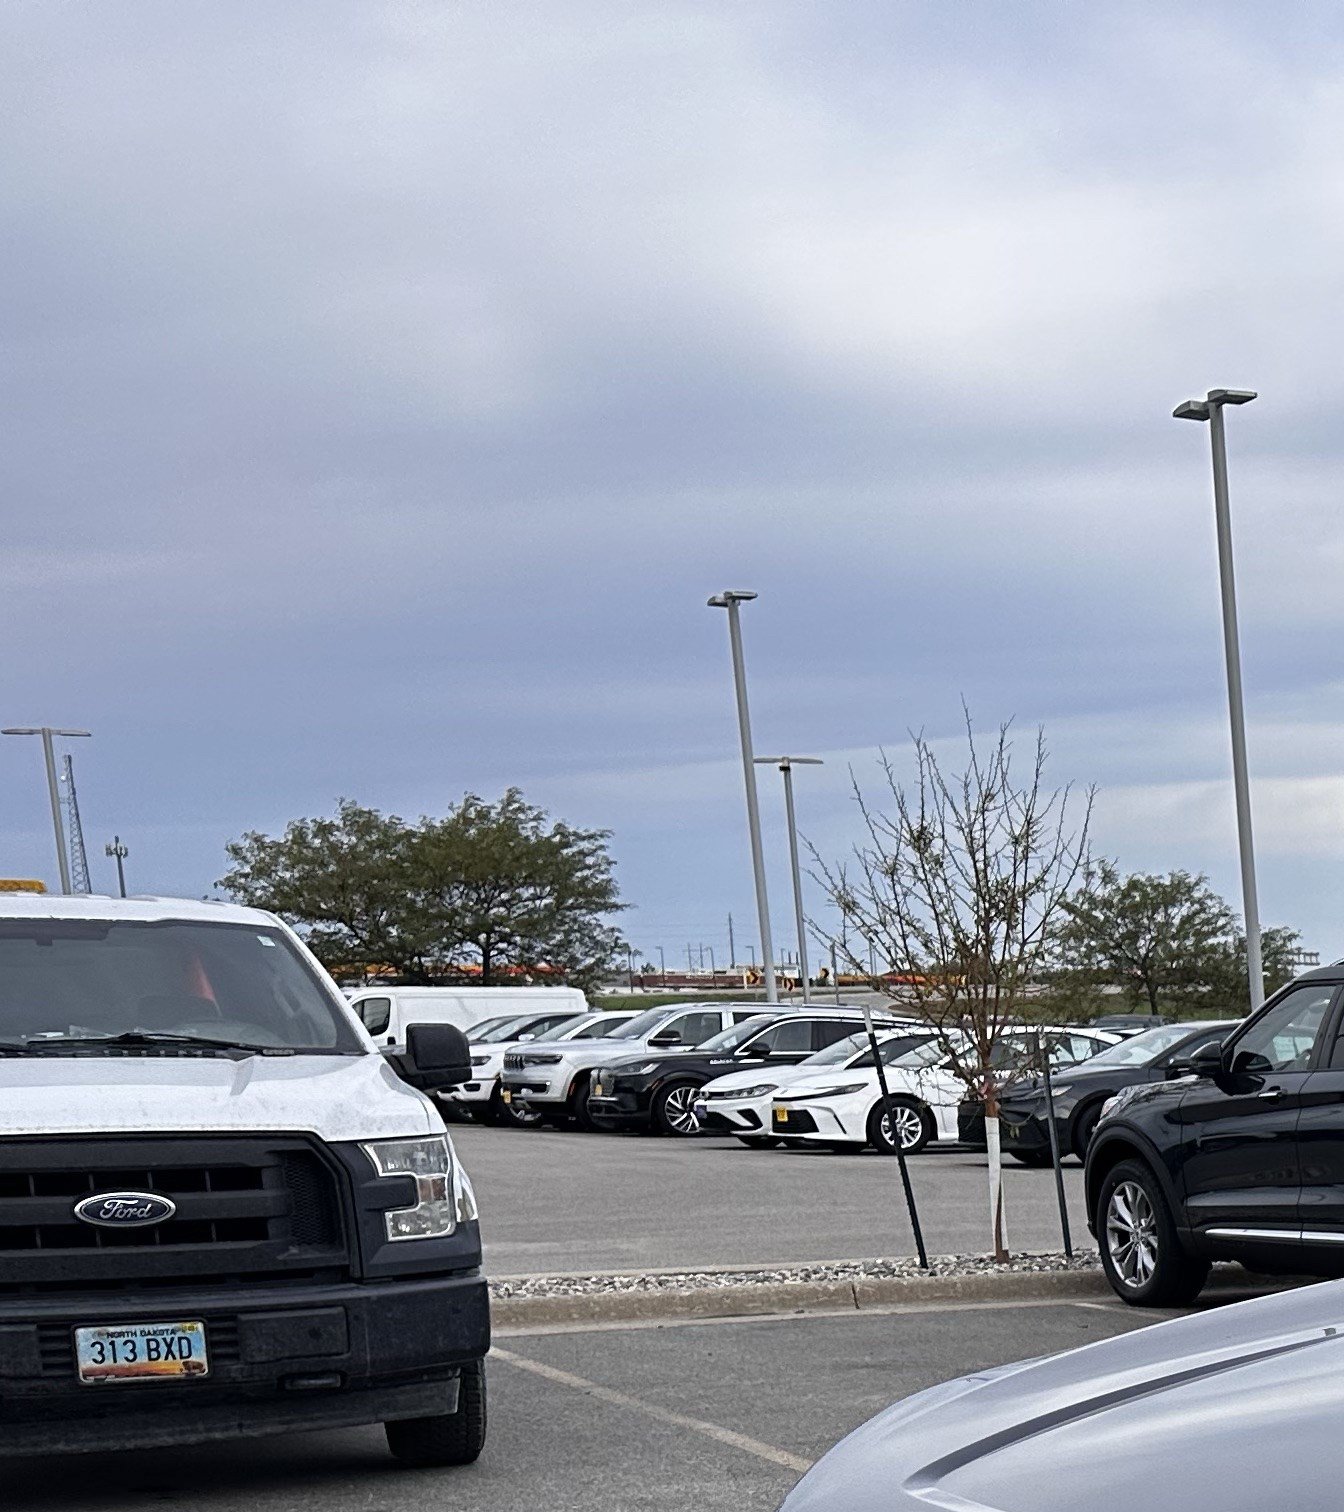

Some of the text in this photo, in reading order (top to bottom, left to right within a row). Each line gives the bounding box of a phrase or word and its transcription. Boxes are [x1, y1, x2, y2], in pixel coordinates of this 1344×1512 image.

[99, 1199, 153, 1220] Ford
[106, 1331, 137, 1339] NORTH
[140, 1327, 177, 1337] DAKOTA
[90, 1335, 193, 1365] 313 BXD
